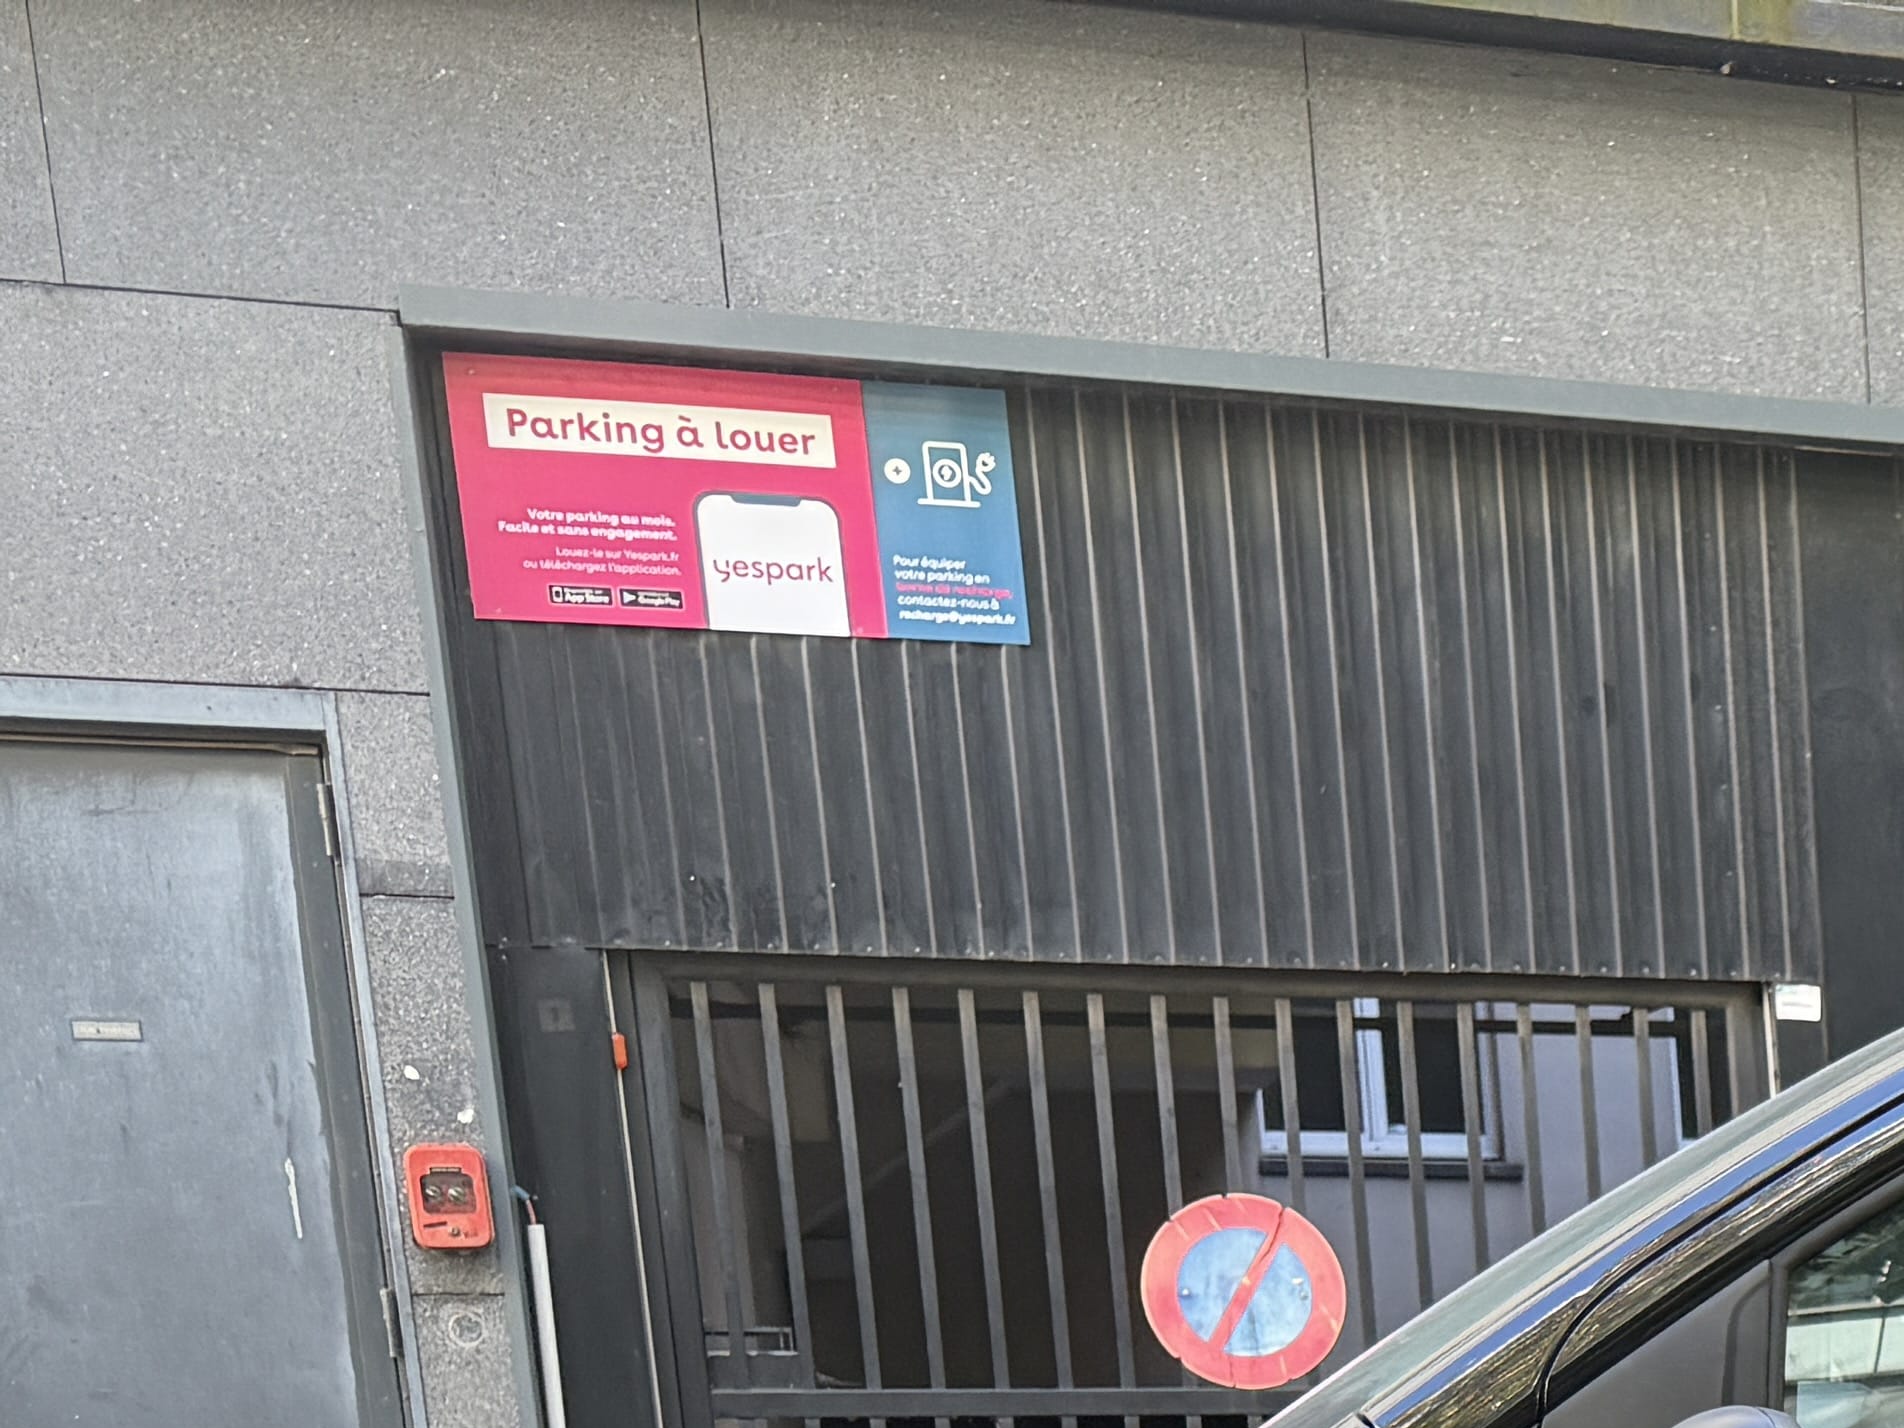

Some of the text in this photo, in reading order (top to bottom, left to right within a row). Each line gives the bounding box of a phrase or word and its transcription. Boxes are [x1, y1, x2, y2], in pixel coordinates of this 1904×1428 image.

[506, 407, 816, 455] Parking à louer
[527, 508, 676, 527] Votre parking au mois.
[498, 520, 678, 541] Facile et sans engagement.
[556, 546, 680, 562] Louez-le sur Yespark.fr
[893, 554, 919, 566] Pour
[523, 560, 538, 569] ou
[712, 558, 834, 585] yespark
[894, 570, 991, 585] votre parking en
